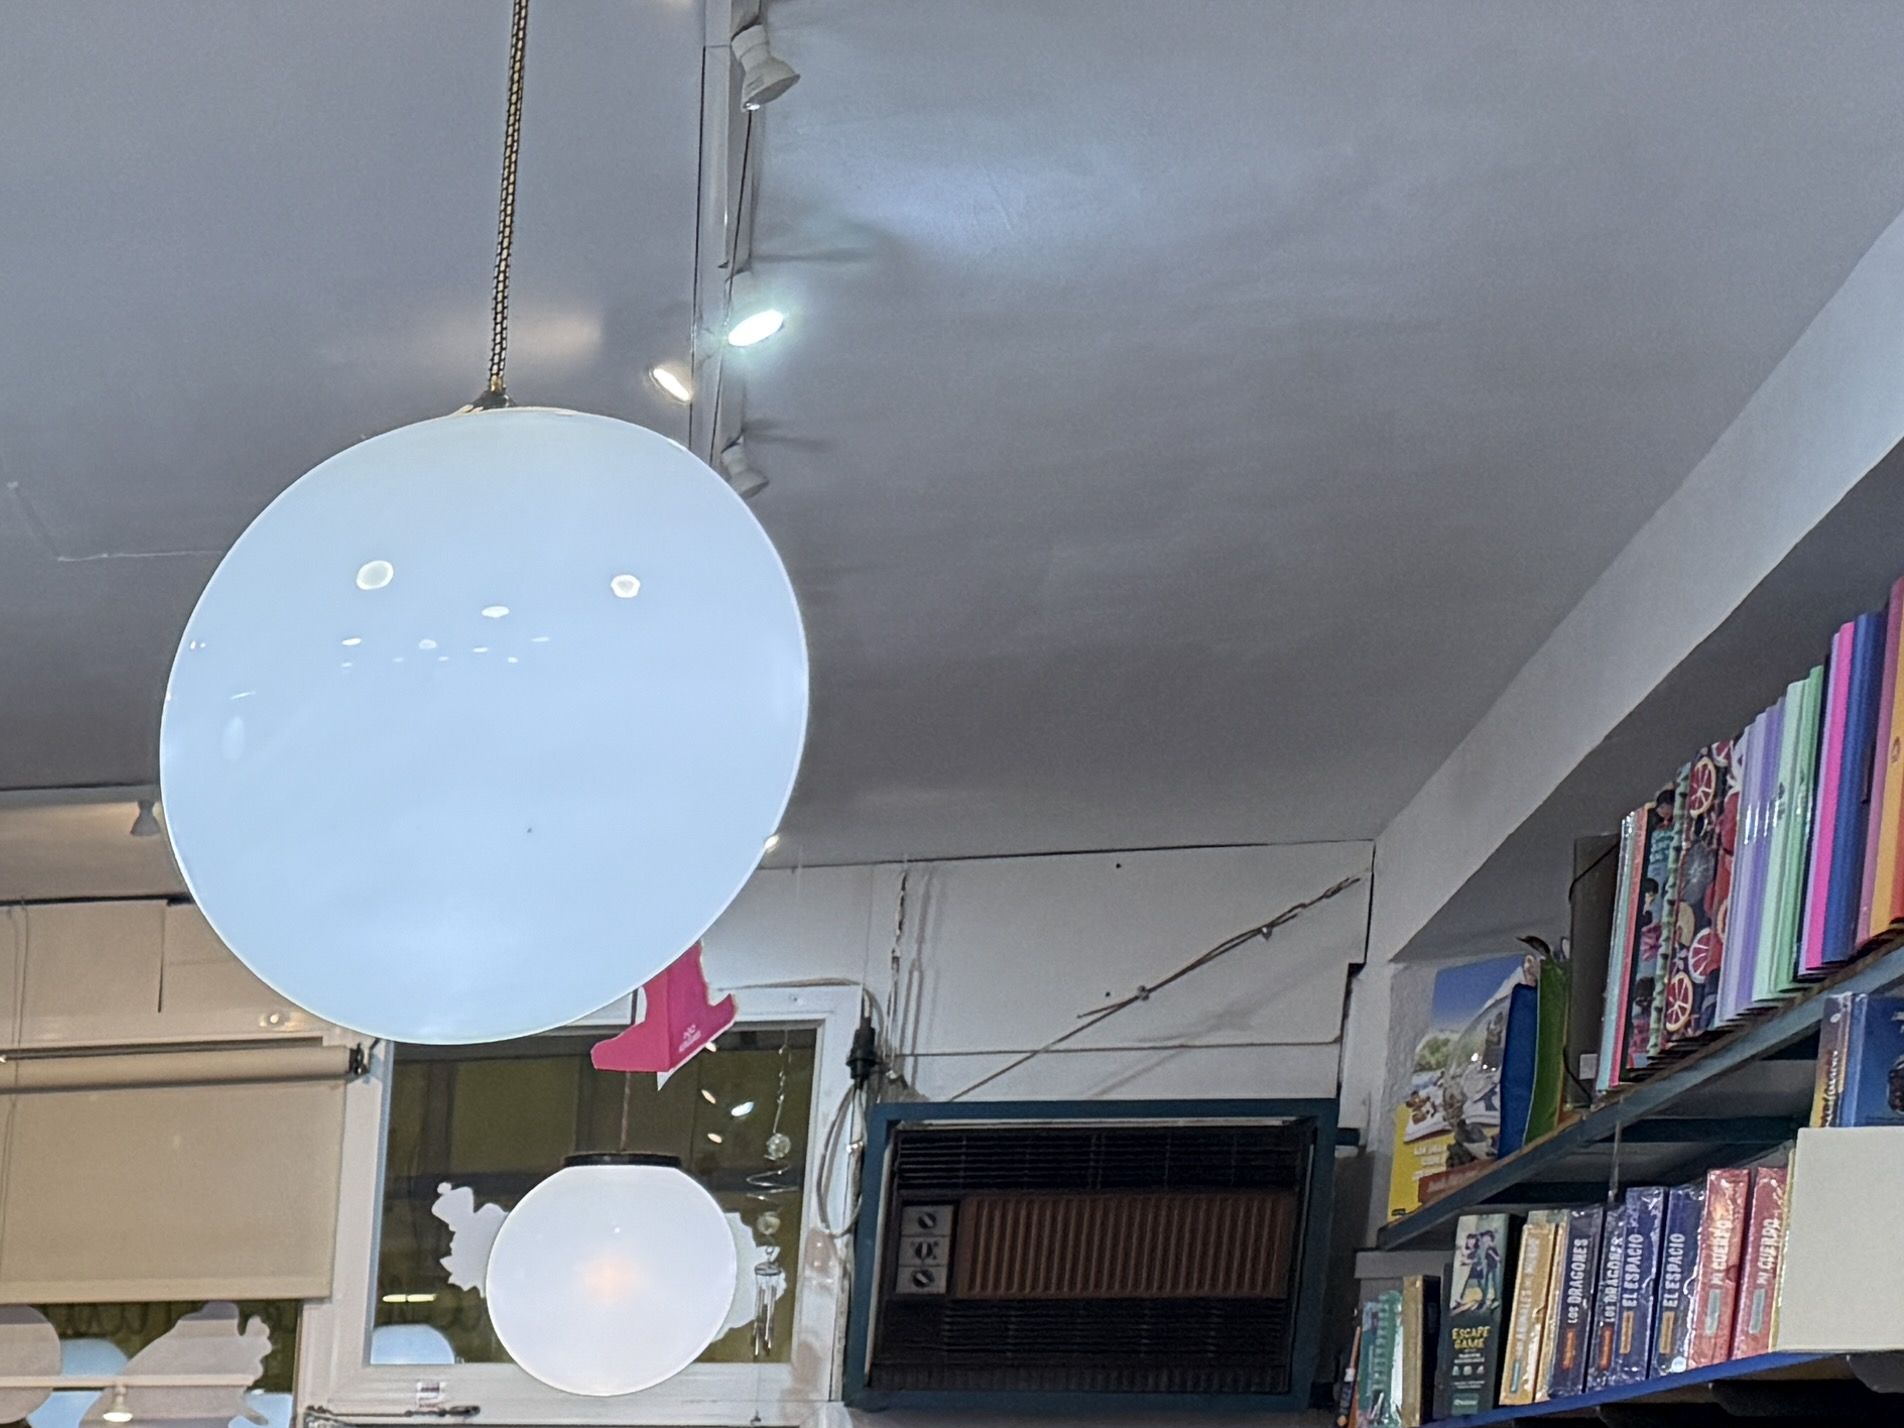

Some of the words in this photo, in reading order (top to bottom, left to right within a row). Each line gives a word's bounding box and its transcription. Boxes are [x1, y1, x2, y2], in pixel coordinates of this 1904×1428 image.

[1624, 1233, 1644, 1289] ESPACIO
[1665, 1233, 1686, 1289] ESPACIO
[1712, 1219, 1732, 1271] CUERPO
[1759, 1218, 1781, 1270] CUERPO
[1569, 1238, 1588, 1302] DRAGONES
[1568, 1302, 1579, 1323] LOS
[1622, 1291, 1637, 1307] EL
[1663, 1291, 1678, 1307] EL
[1452, 1326, 1491, 1340] ESCAPE
[1454, 1338, 1485, 1349] GAME
